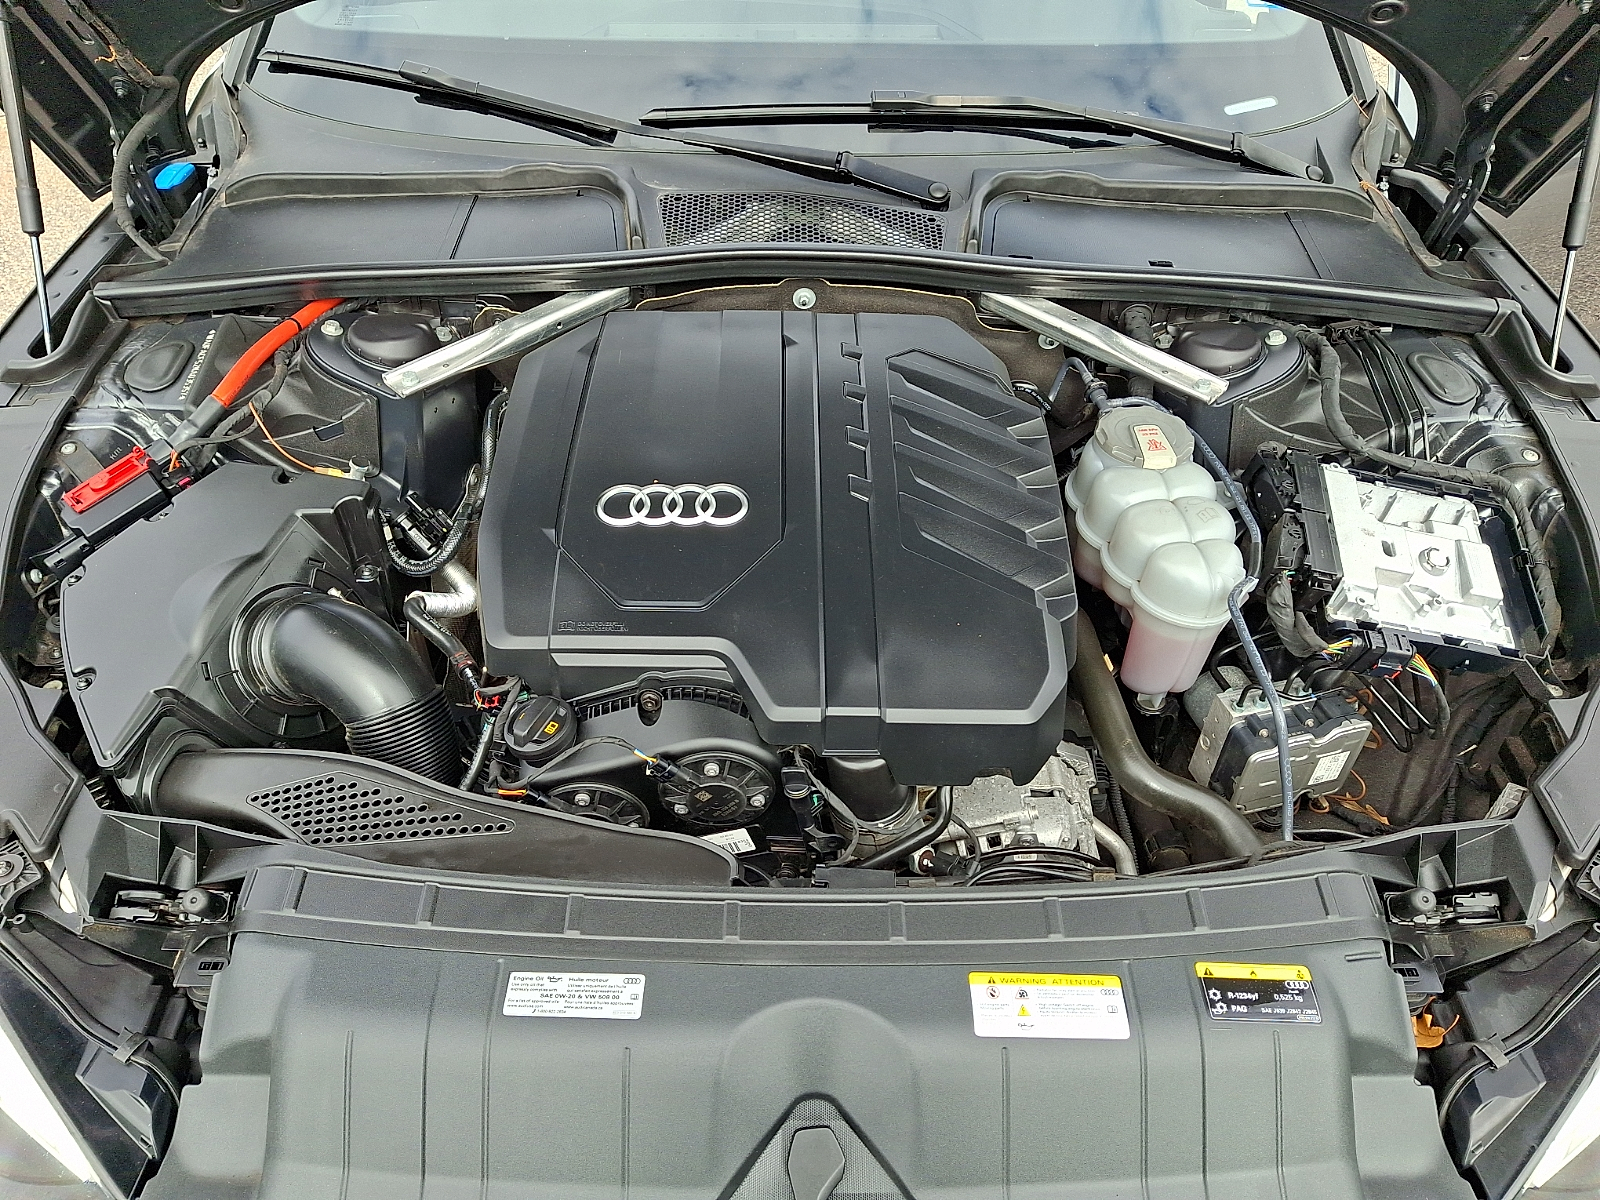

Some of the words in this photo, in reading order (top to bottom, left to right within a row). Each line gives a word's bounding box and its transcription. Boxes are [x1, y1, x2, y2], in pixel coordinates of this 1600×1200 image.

[1052, 978, 1105, 986] ATTENTION
[1228, 991, 1259, 1001] R-1234yf
[1293, 994, 1303, 1002] kg
